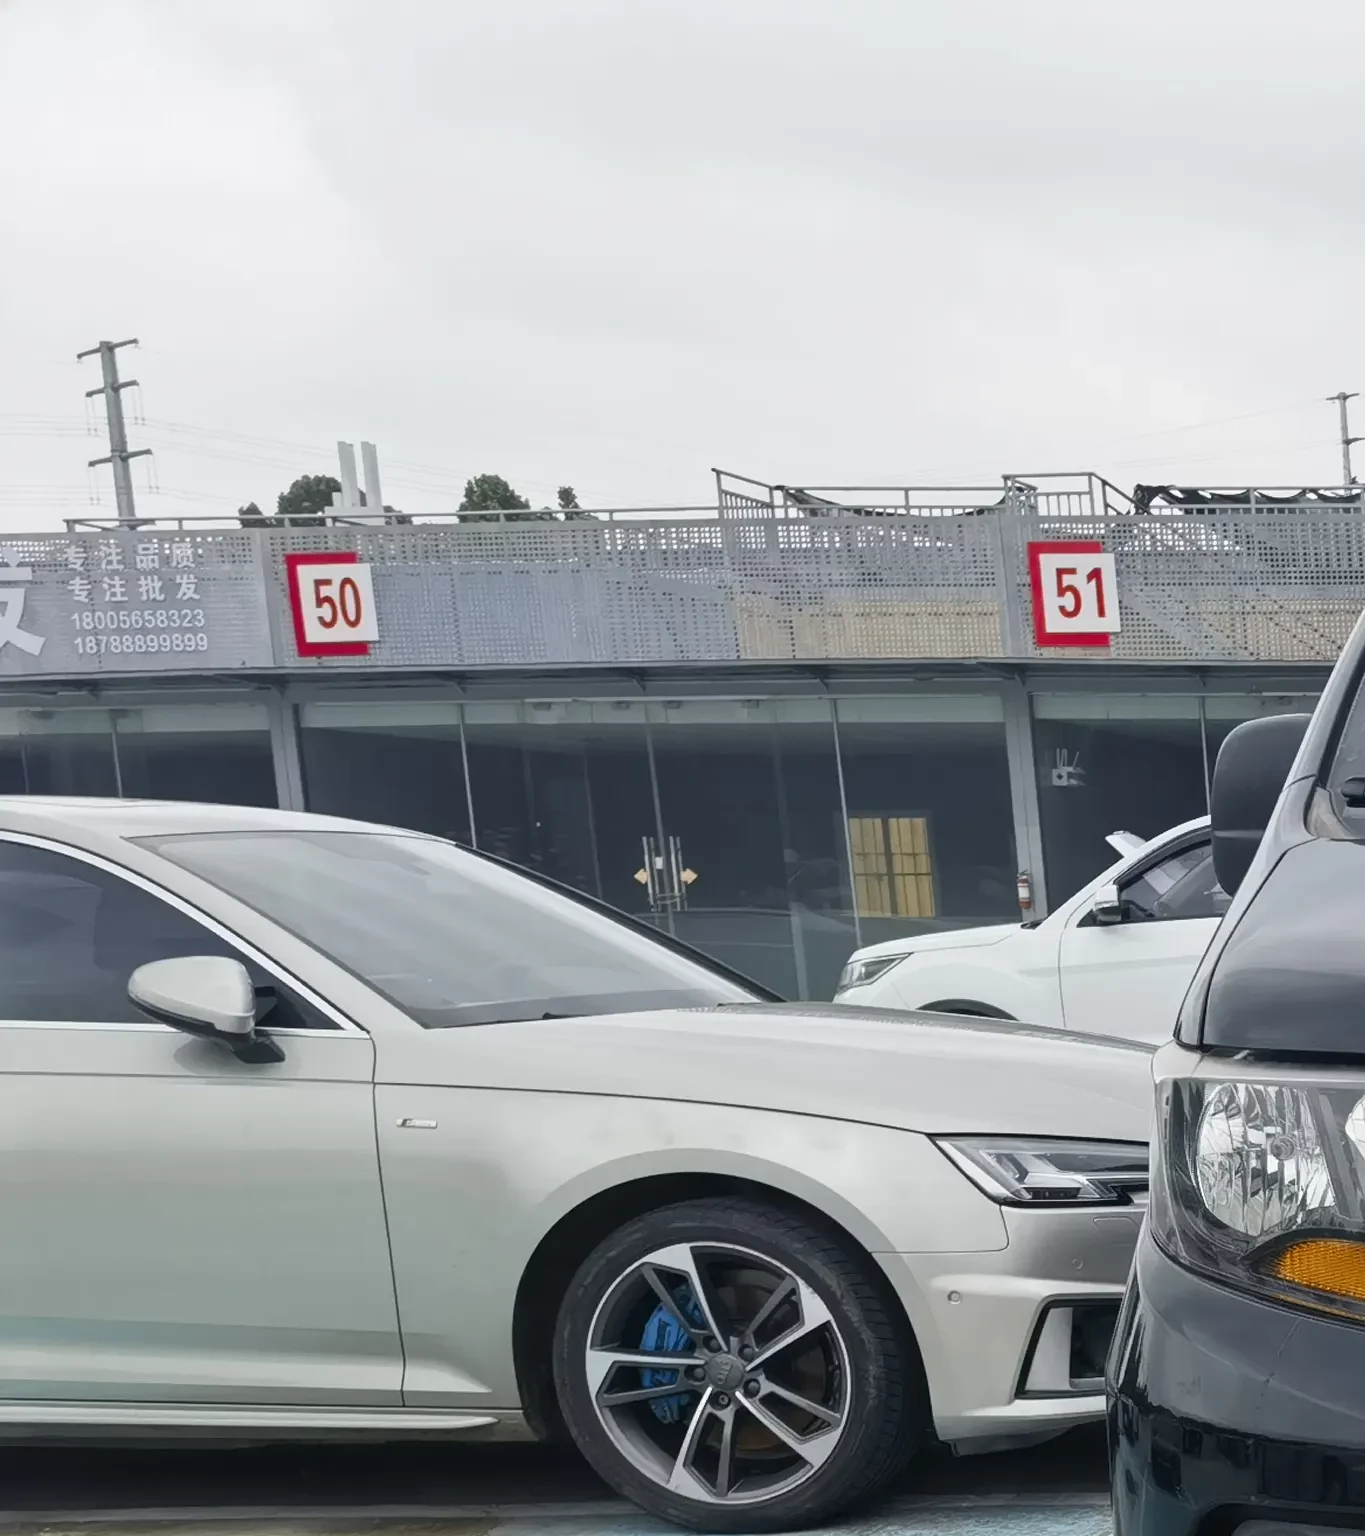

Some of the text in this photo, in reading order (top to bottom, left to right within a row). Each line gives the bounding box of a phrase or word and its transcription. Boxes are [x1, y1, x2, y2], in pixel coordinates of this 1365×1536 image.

[63, 542, 197, 571] 专注品质
[67, 574, 201, 602] 专注批发
[1055, 567, 1106, 619] 51
[313, 576, 362, 629] 50
[70, 608, 205, 630] 18005658323
[74, 633, 208, 654] 18788899899
